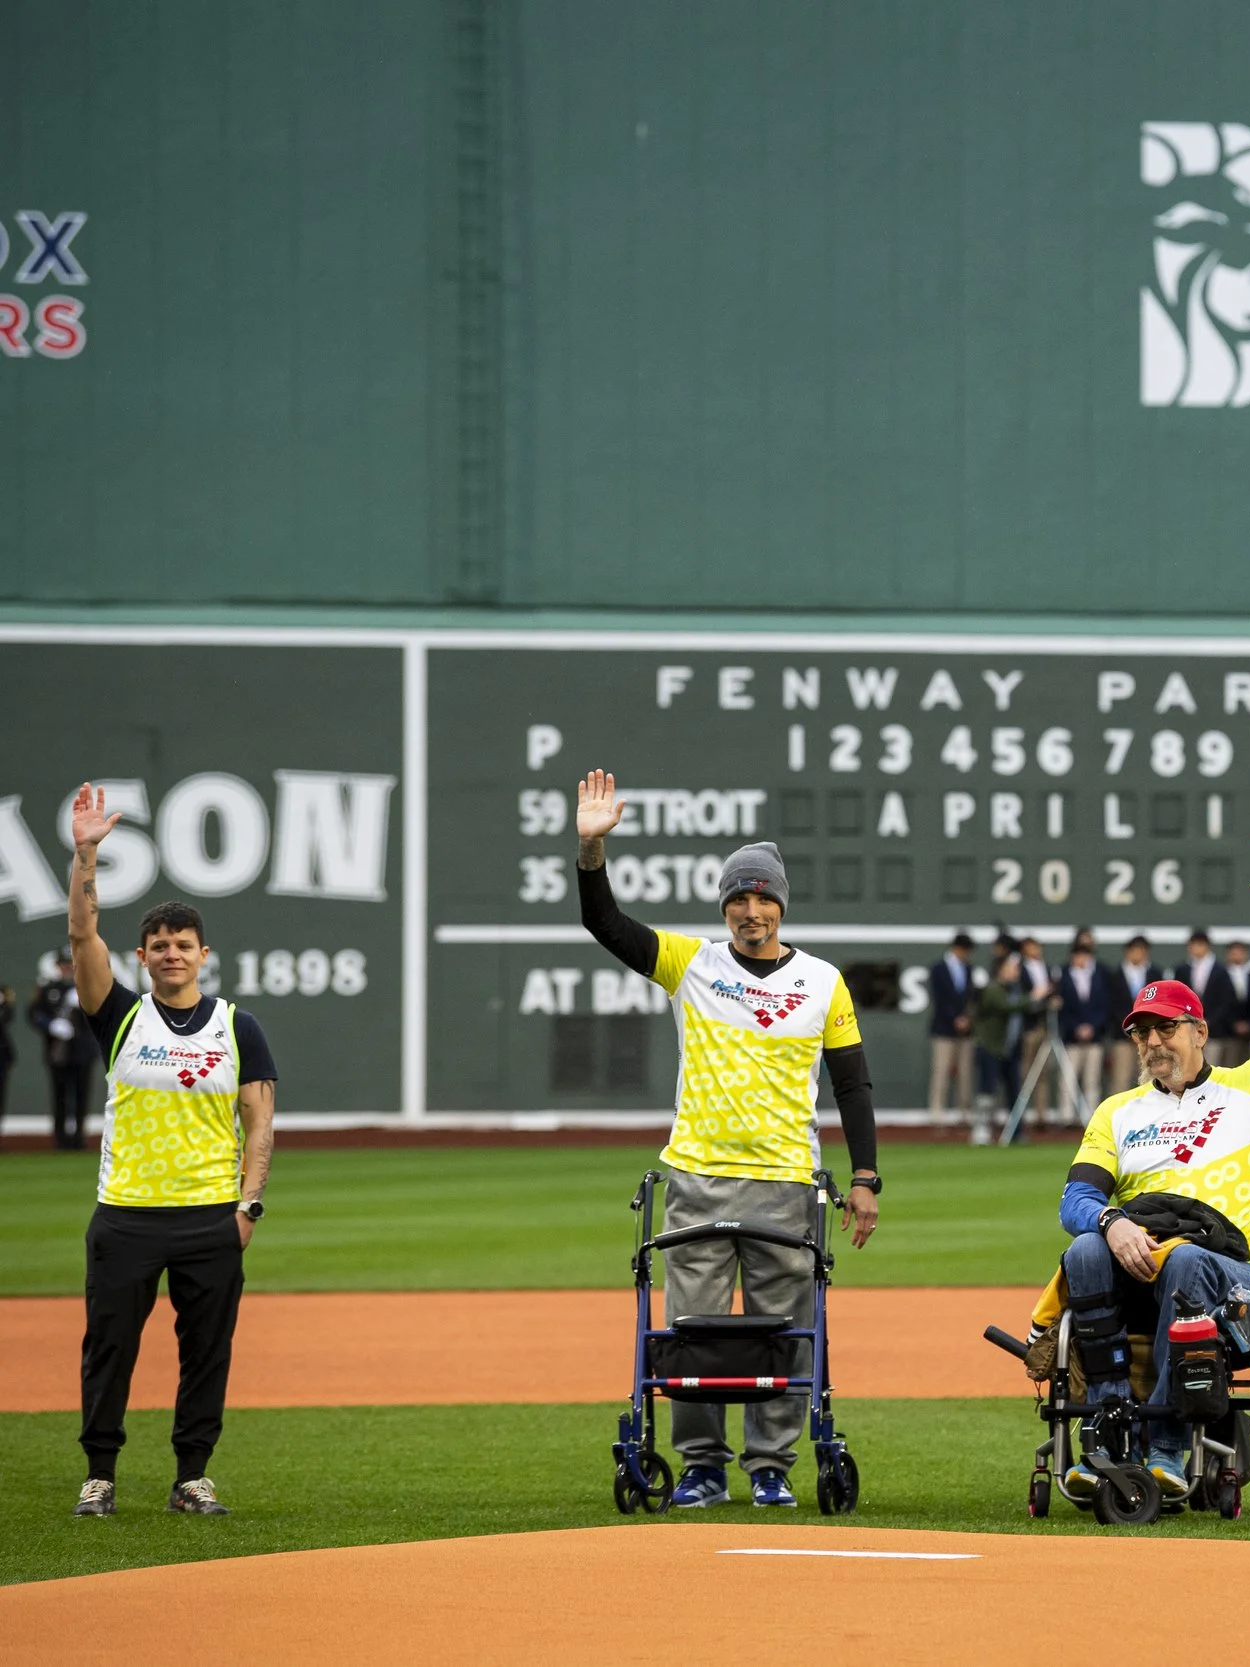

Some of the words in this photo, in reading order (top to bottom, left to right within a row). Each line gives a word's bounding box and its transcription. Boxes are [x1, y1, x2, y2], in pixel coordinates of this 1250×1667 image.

[0, 209, 90, 285] X
[656, 665, 1024, 712] FENWAY
[526, 723, 563, 771] P
[788, 723, 806, 772] 1
[829, 724, 862, 772] 2
[877, 723, 912, 774] 3
[940, 726, 978, 773] 4
[992, 727, 1026, 776] 5
[1036, 727, 1074, 777] 6
[1103, 728, 1134, 775] 7
[1150, 729, 1186, 777] 8
[1197, 729, 1234, 777] 9
[519, 789, 567, 837] 59
[613, 788, 768, 838] ETROIT
[519, 856, 567, 903] 35
[605, 854, 722, 904] OSTO
[992, 858, 1184, 905] 2026
[236, 948, 367, 997] 1898
[519, 969, 583, 1015] AT
